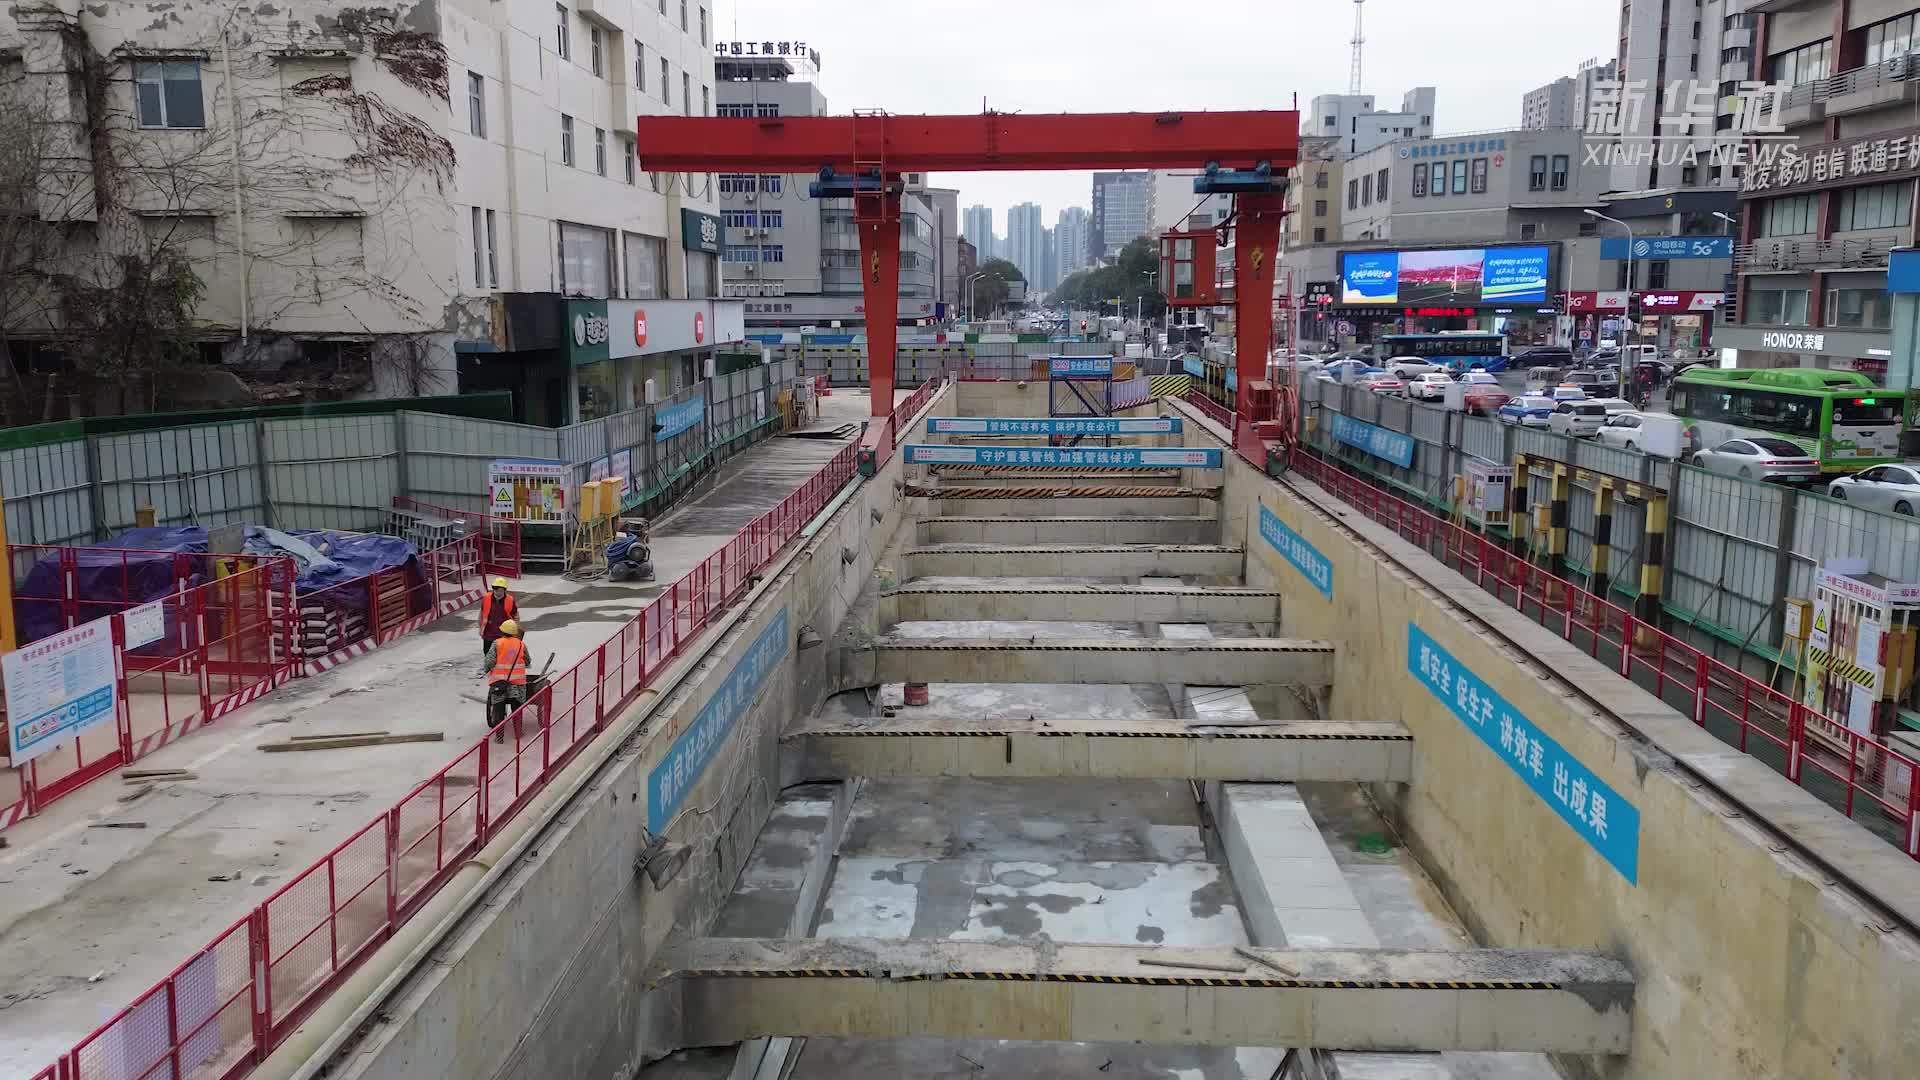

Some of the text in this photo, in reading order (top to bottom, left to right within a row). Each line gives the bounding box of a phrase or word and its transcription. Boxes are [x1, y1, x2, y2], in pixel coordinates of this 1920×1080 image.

[715, 41, 807, 56] 中国工商银行
[1654, 240, 1686, 249] 中国移动
[1692, 241, 1713, 255] 5G
[990, 421, 1050, 432] 管线不容有失
[981, 450, 1135, 464] 守护重要管线 加强管线保护
[1456, 675, 1494, 728] 促生产
[1500, 711, 1545, 778] 讲效率
[1552, 761, 1608, 840] 出成果
